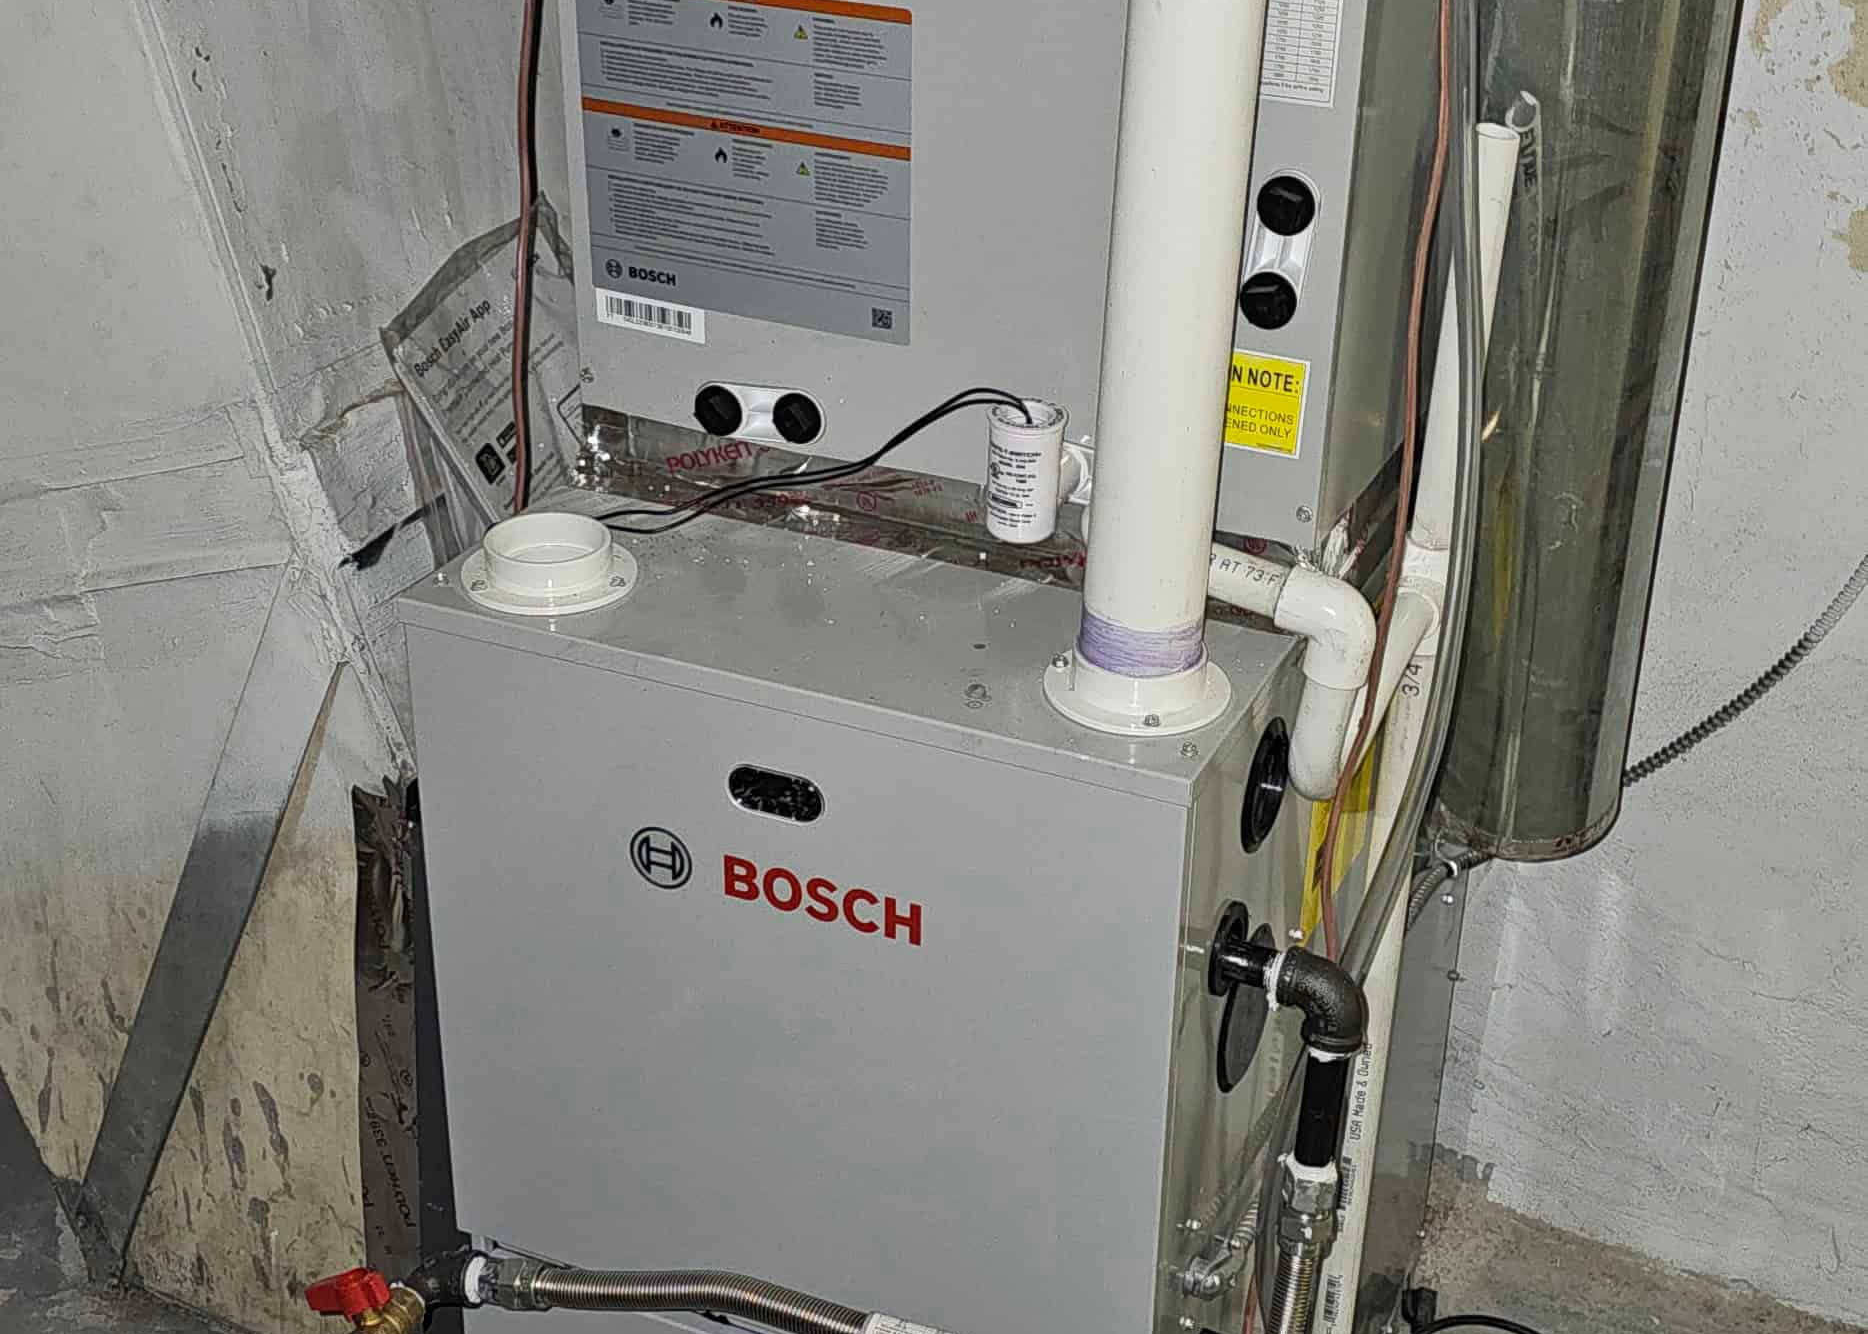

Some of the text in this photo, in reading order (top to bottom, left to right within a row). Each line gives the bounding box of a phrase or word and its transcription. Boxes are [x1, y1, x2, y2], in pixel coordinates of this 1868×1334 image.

[629, 266, 677, 287] BOSCH
[469, 297, 493, 324] App
[1247, 367, 1301, 395] NOTE:
[1259, 424, 1293, 440] ONLY
[723, 854, 922, 947] BOSCH
[1353, 1090, 1368, 1117] Made
[1350, 1119, 1362, 1142] USA
